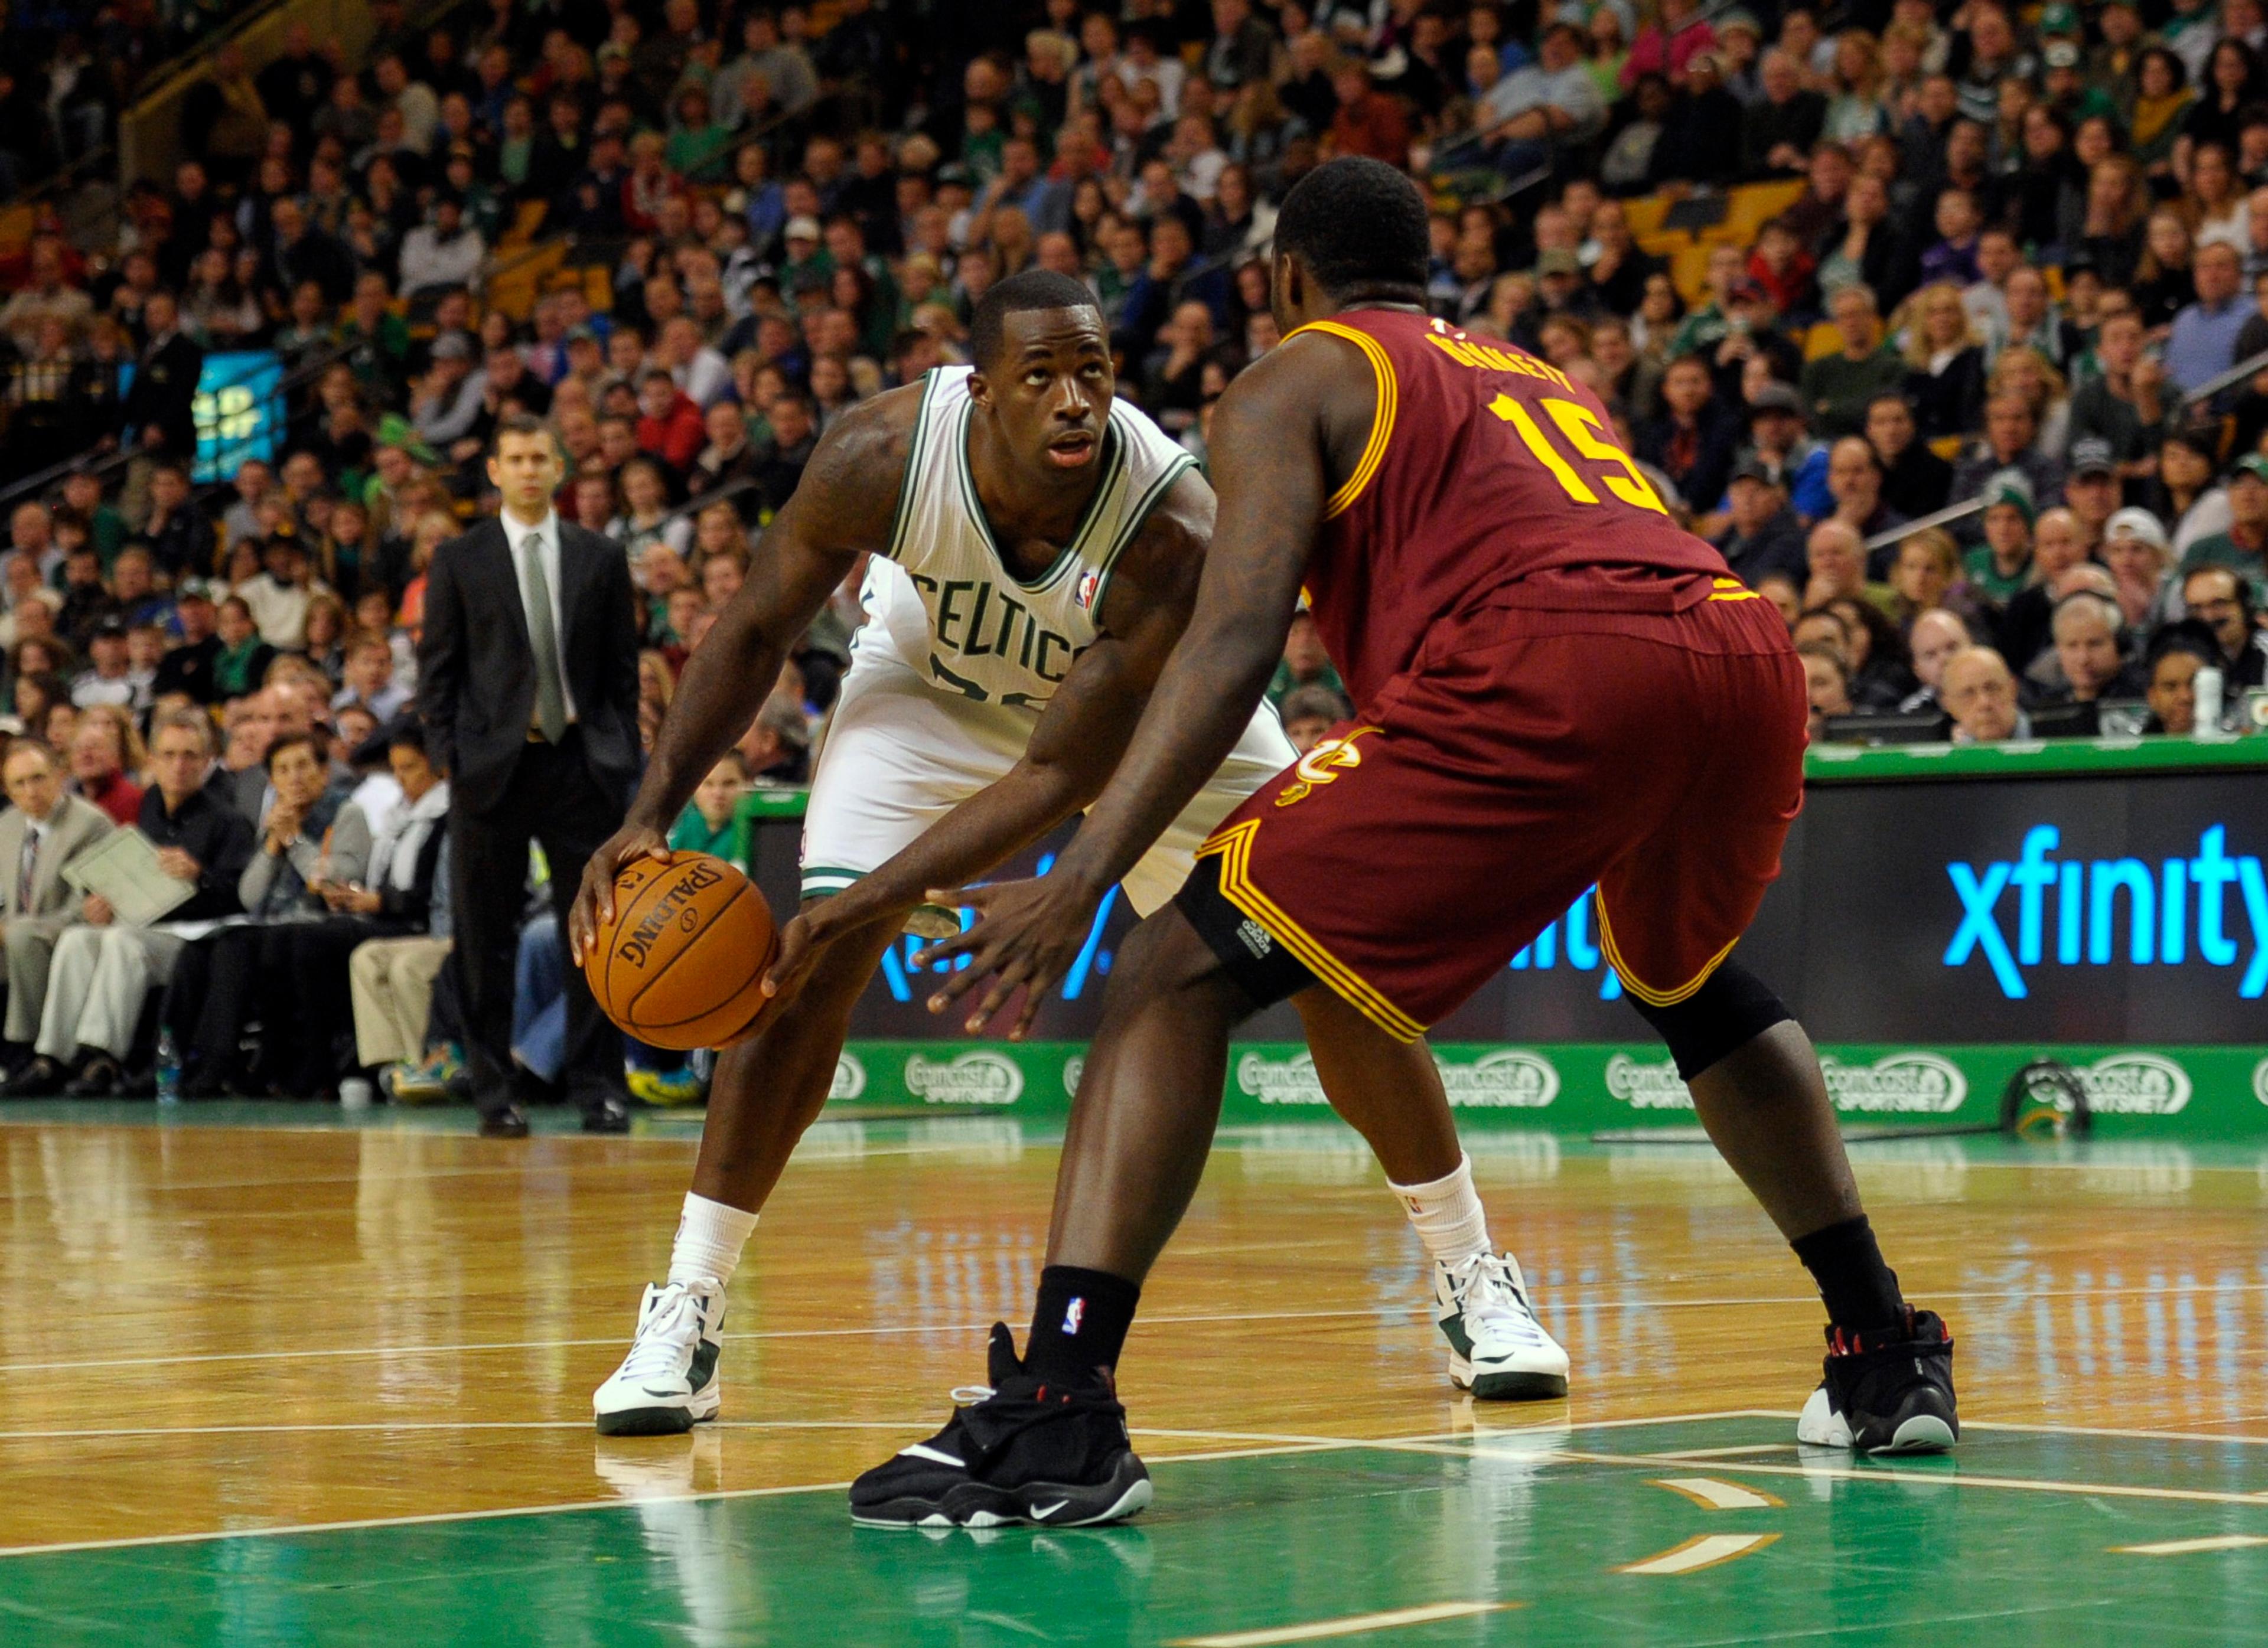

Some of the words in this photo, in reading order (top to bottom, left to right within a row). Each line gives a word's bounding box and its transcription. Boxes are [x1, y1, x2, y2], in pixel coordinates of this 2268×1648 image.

[1488, 393, 1669, 515] 15
[619, 863, 723, 969] SPALDING
[1242, 920, 1271, 954] adidas
[1943, 822, 2268, 999] xfinity
